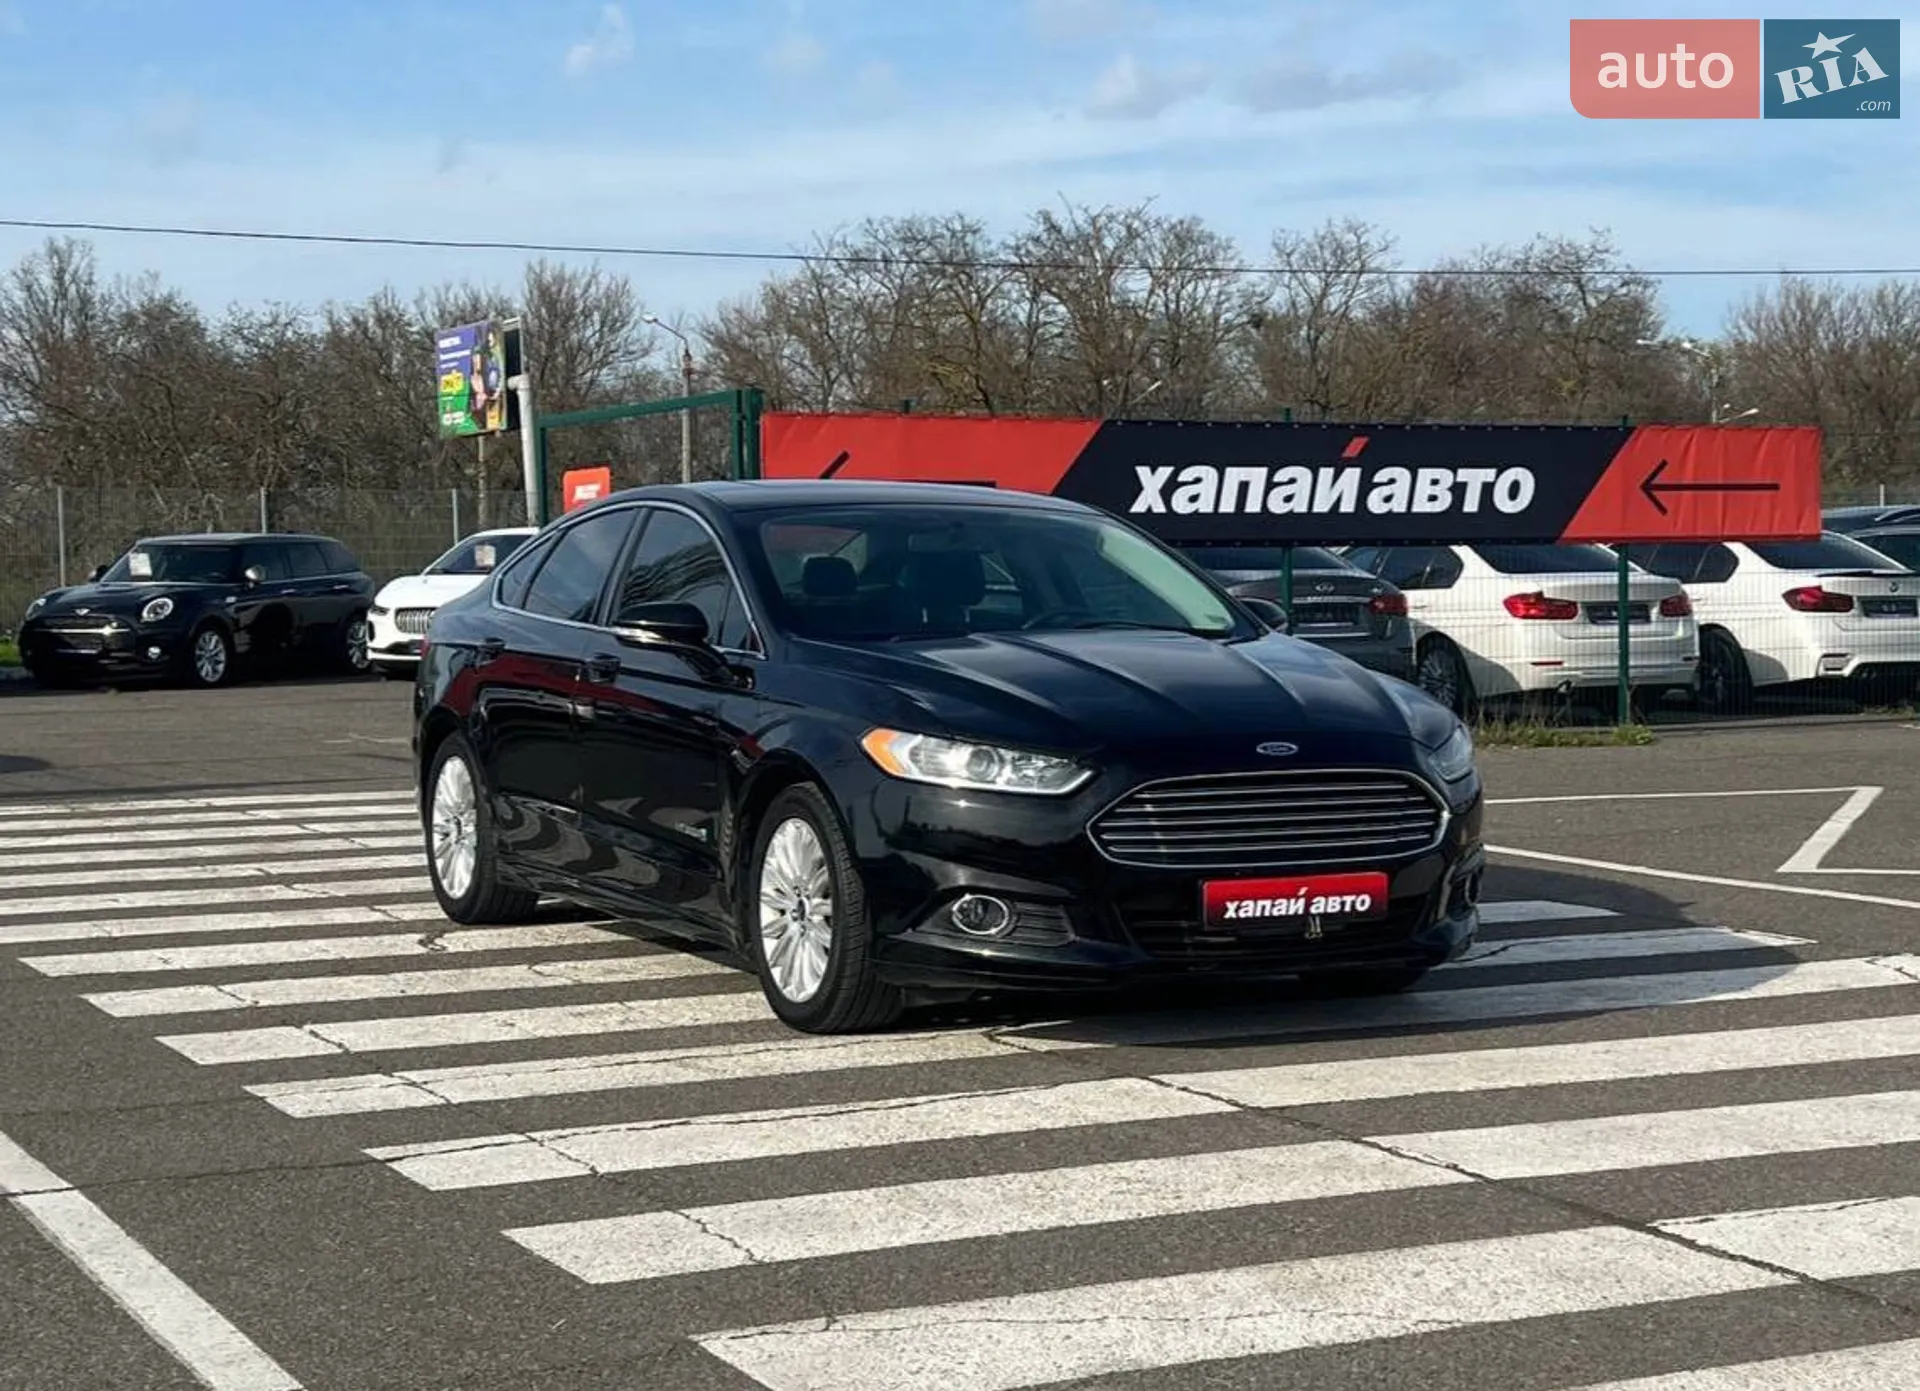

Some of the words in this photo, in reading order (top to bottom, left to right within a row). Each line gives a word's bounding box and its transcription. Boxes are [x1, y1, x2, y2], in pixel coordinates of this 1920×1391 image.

[1128, 436, 1370, 515] хапай
[1366, 466, 1536, 515] авто
[1223, 887, 1309, 919] хапай
[1309, 894, 1371, 914] авто
